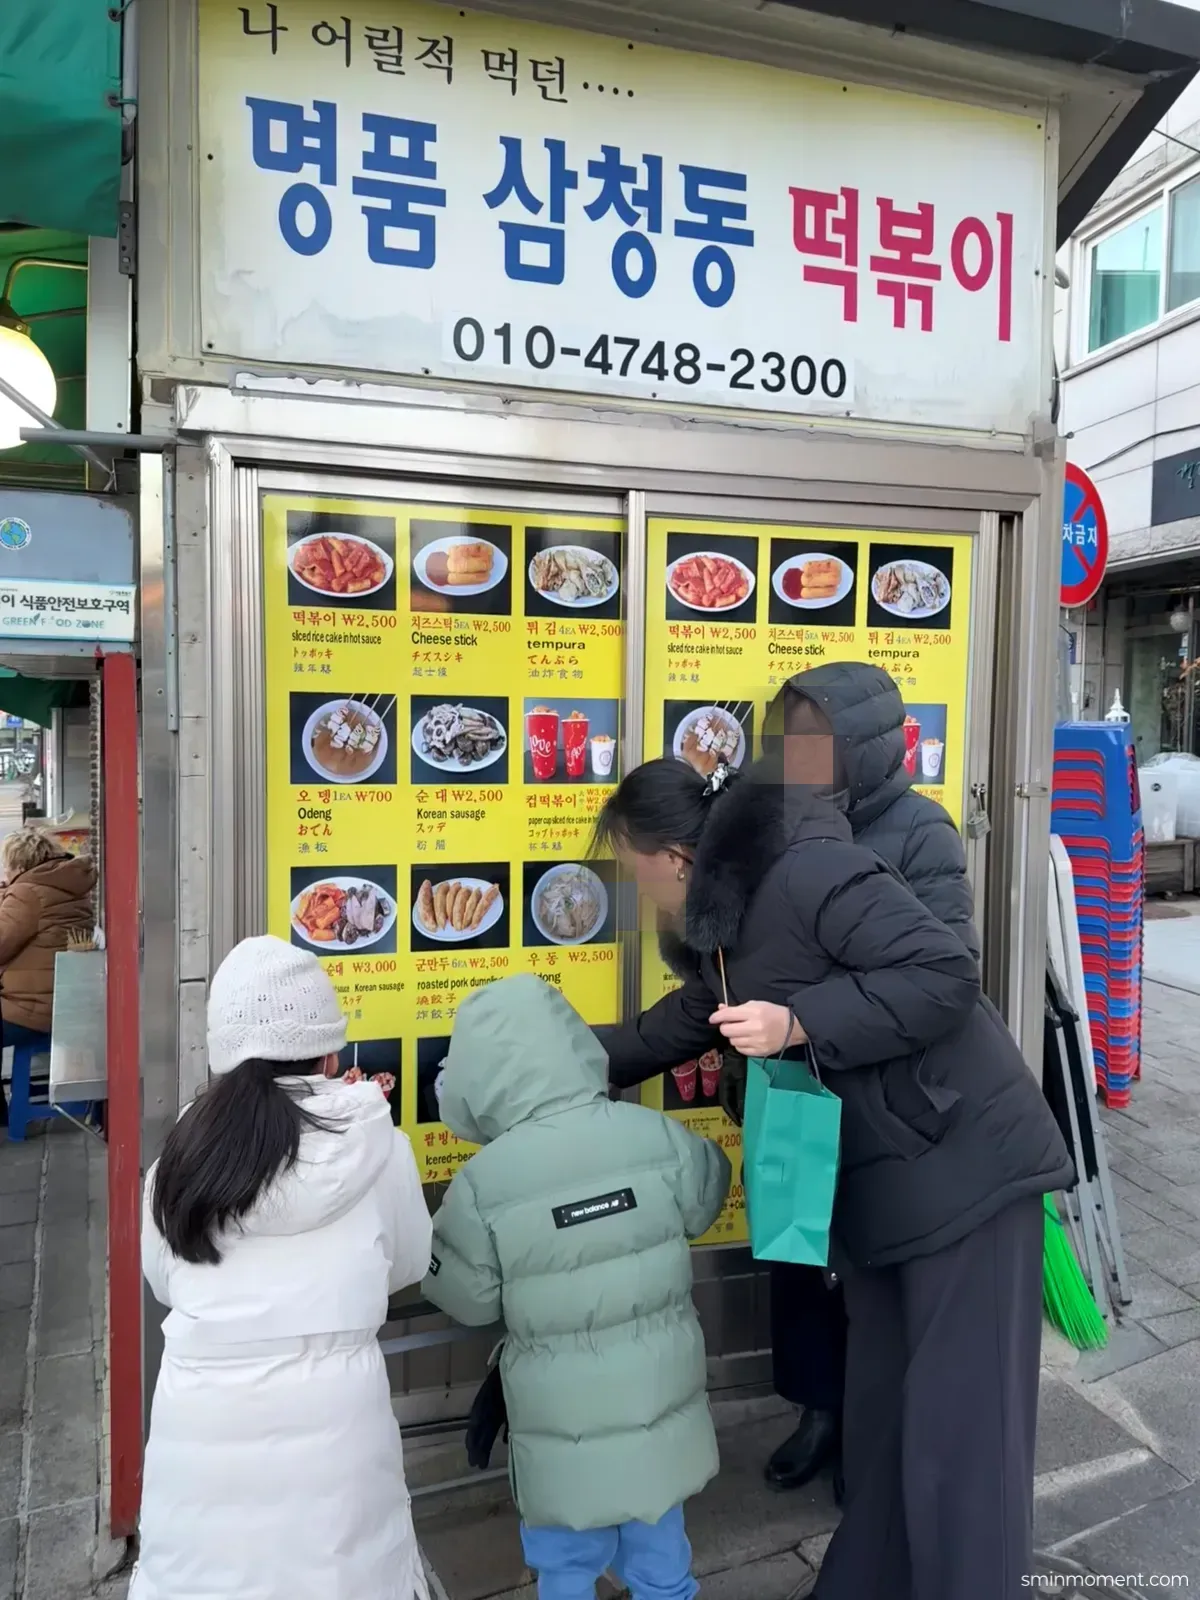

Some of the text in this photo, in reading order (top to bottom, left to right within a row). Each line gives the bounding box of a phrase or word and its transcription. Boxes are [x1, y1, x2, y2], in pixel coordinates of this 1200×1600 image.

[238, 3, 288, 55] 나
[311, 16, 454, 85] 어릴적
[246, 96, 1014, 342] 명품 삼청동 떡볶이
[453, 317, 847, 398] 010-4748-2300
[1062, 522, 1097, 547] 차금지
[20, 595, 130, 615] 식품안전보호구역
[292, 610, 336, 627] 떡볶이
[411, 631, 478, 646] Cheese stick
[668, 624, 705, 639] 떡볶이
[527, 640, 586, 651] tempura
[768, 642, 826, 656] Cheese stick
[868, 649, 920, 659] tempura
[297, 807, 332, 821] Odeng
[416, 808, 486, 821] Korean sausage
[416, 957, 449, 972] 군만두
[354, 983, 377, 992] Korean
[378, 981, 404, 991] sausage
[417, 978, 449, 990] roasted
[450, 977, 468, 989] pork
[571, 1208, 585, 1218] new
[584, 1202, 609, 1214] balance
